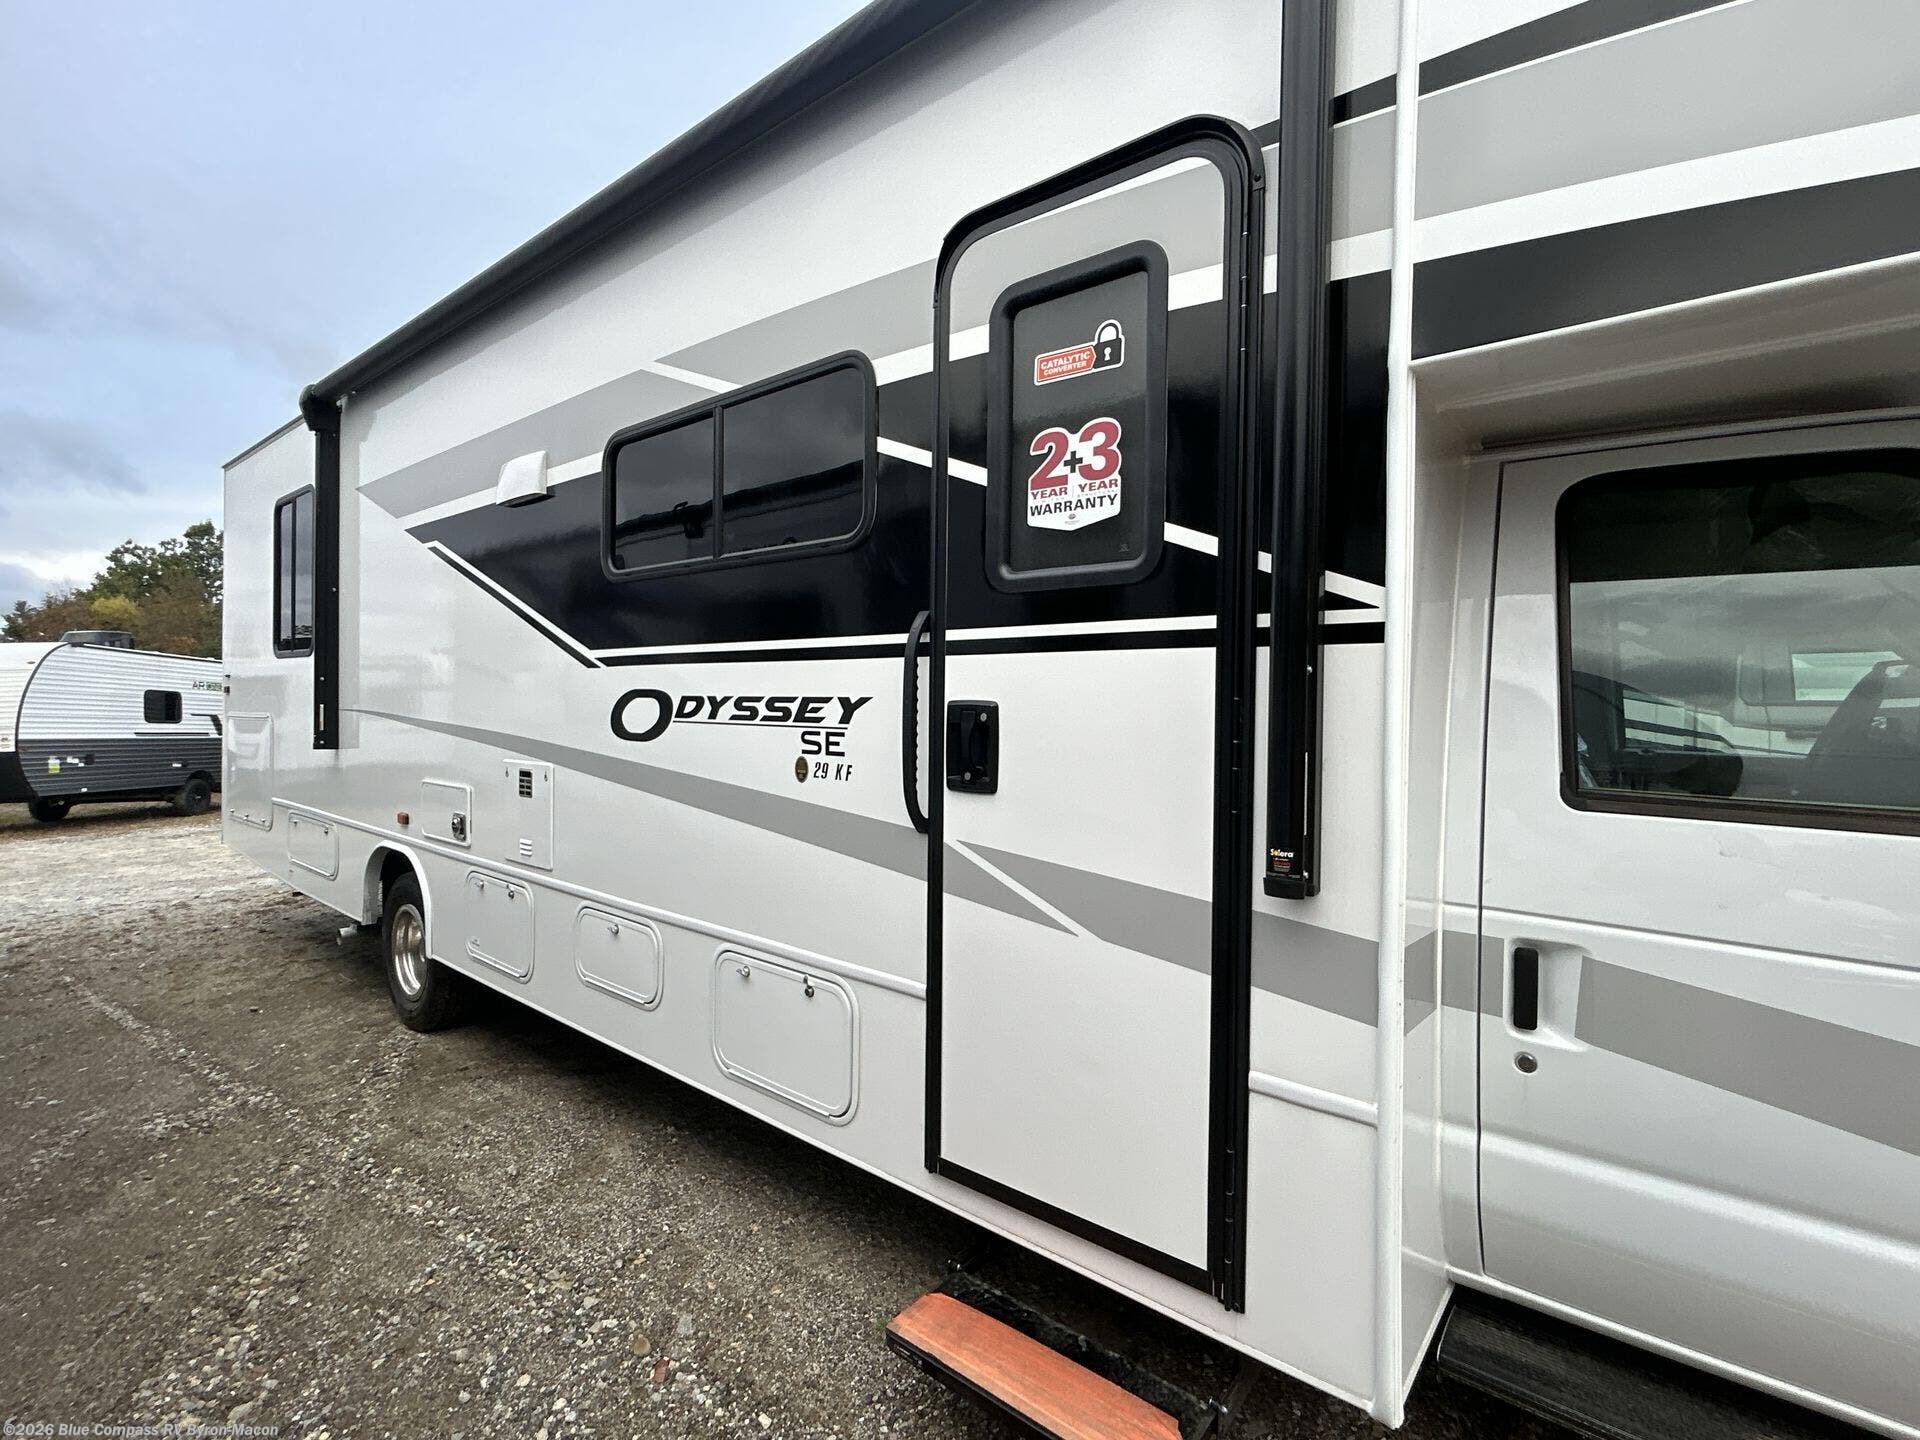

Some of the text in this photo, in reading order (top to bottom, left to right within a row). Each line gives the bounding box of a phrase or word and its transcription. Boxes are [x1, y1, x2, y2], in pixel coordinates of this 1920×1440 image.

[1041, 351, 1091, 370] CATALYTIC
[1043, 361, 1088, 376] CONVERTER
[1030, 478, 1119, 500] YEAR YEAR
[1030, 493, 1118, 517] WARRANTY
[800, 730, 846, 757] SE
[813, 761, 829, 779] 29
[1270, 848, 1294, 858] Solera
